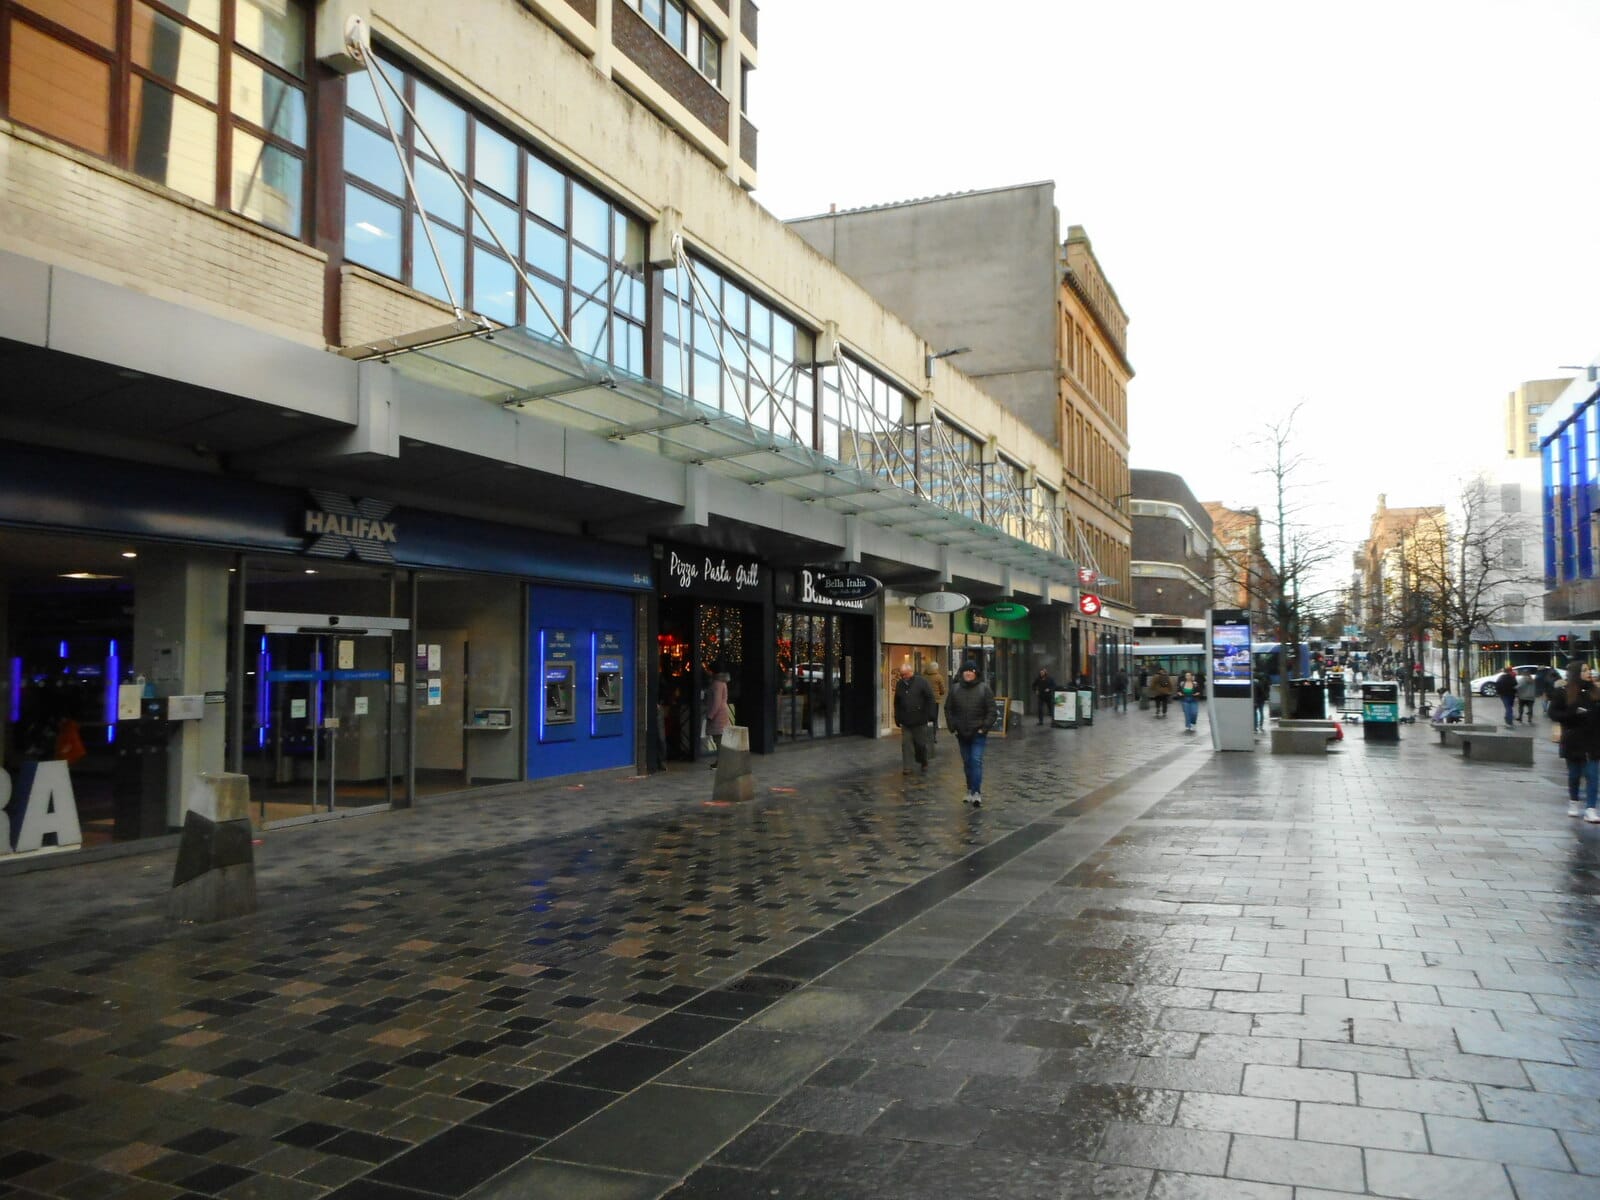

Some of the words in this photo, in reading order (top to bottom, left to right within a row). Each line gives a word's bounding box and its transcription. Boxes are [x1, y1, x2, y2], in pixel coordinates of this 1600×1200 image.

[305, 510, 397, 542] HALIFAX
[670, 551, 698, 588] Pizza
[704, 557, 731, 582] Pasta
[824, 579, 844, 588] Bella
[846, 578, 867, 588] Italia
